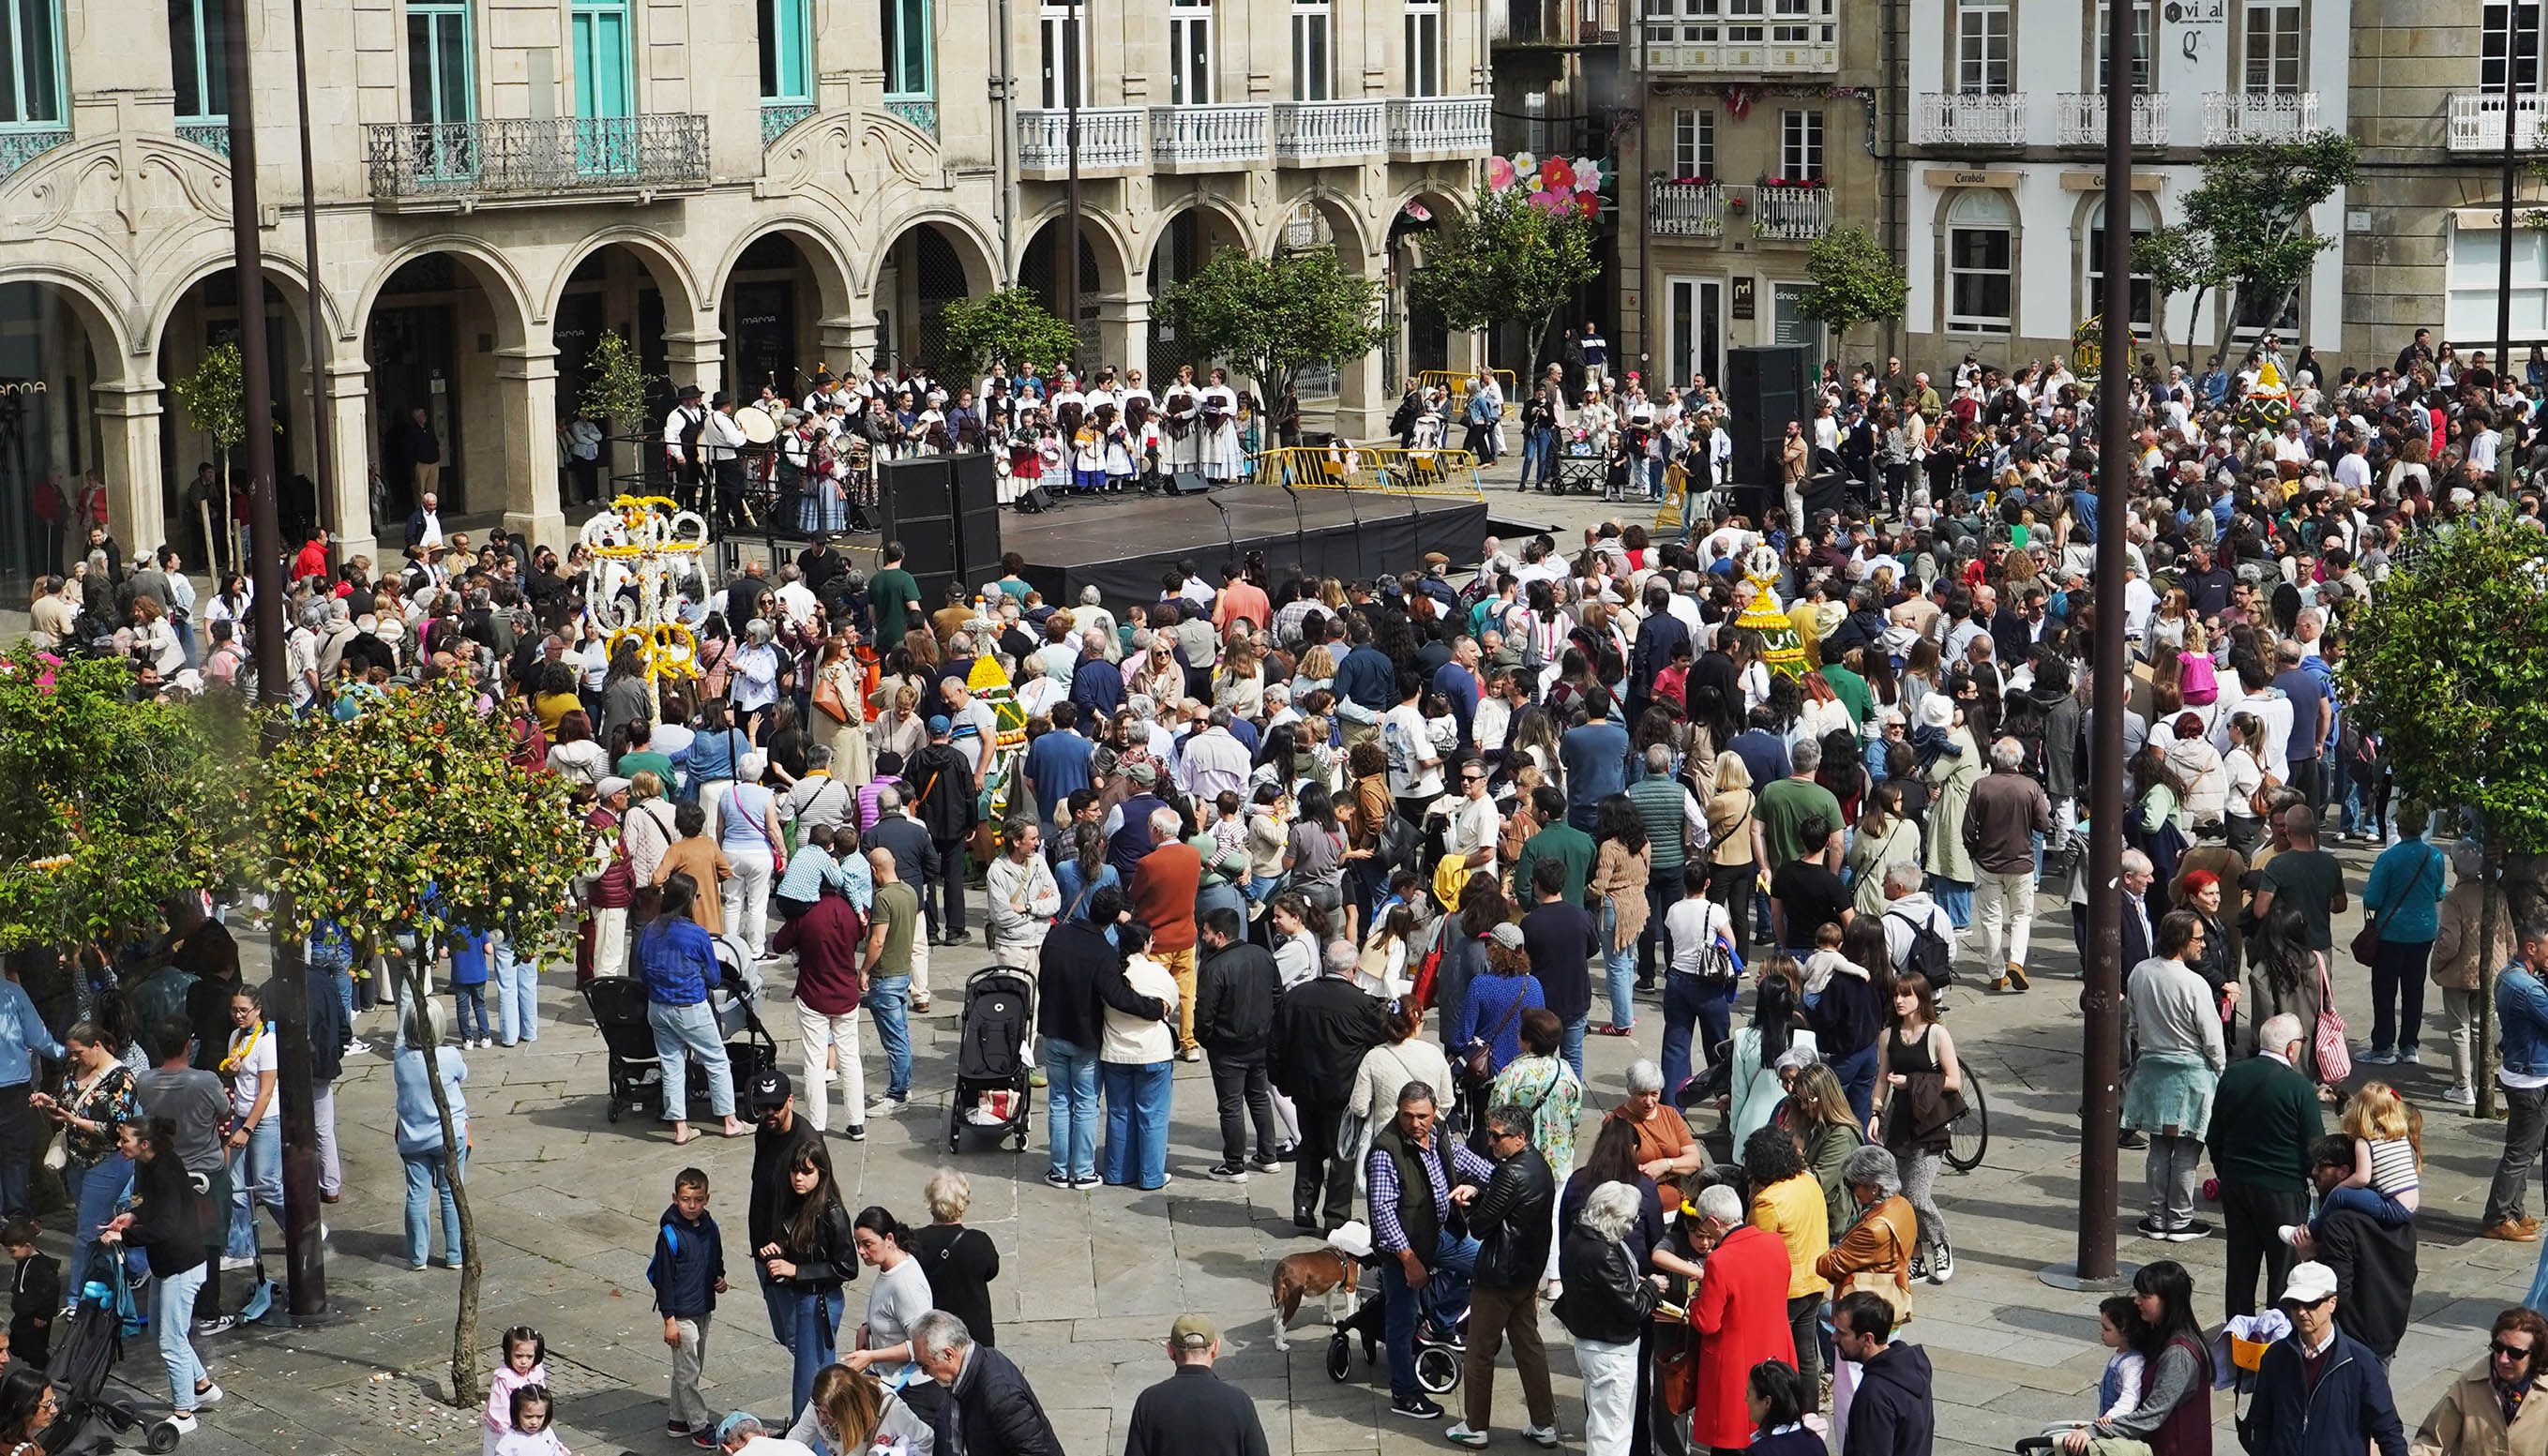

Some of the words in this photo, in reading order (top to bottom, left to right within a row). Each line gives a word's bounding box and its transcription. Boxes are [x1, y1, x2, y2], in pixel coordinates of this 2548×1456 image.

[2183, 0, 2224, 17] vial
[1954, 173, 1986, 184] Carabela
[2492, 212, 2529, 225] Cabel
